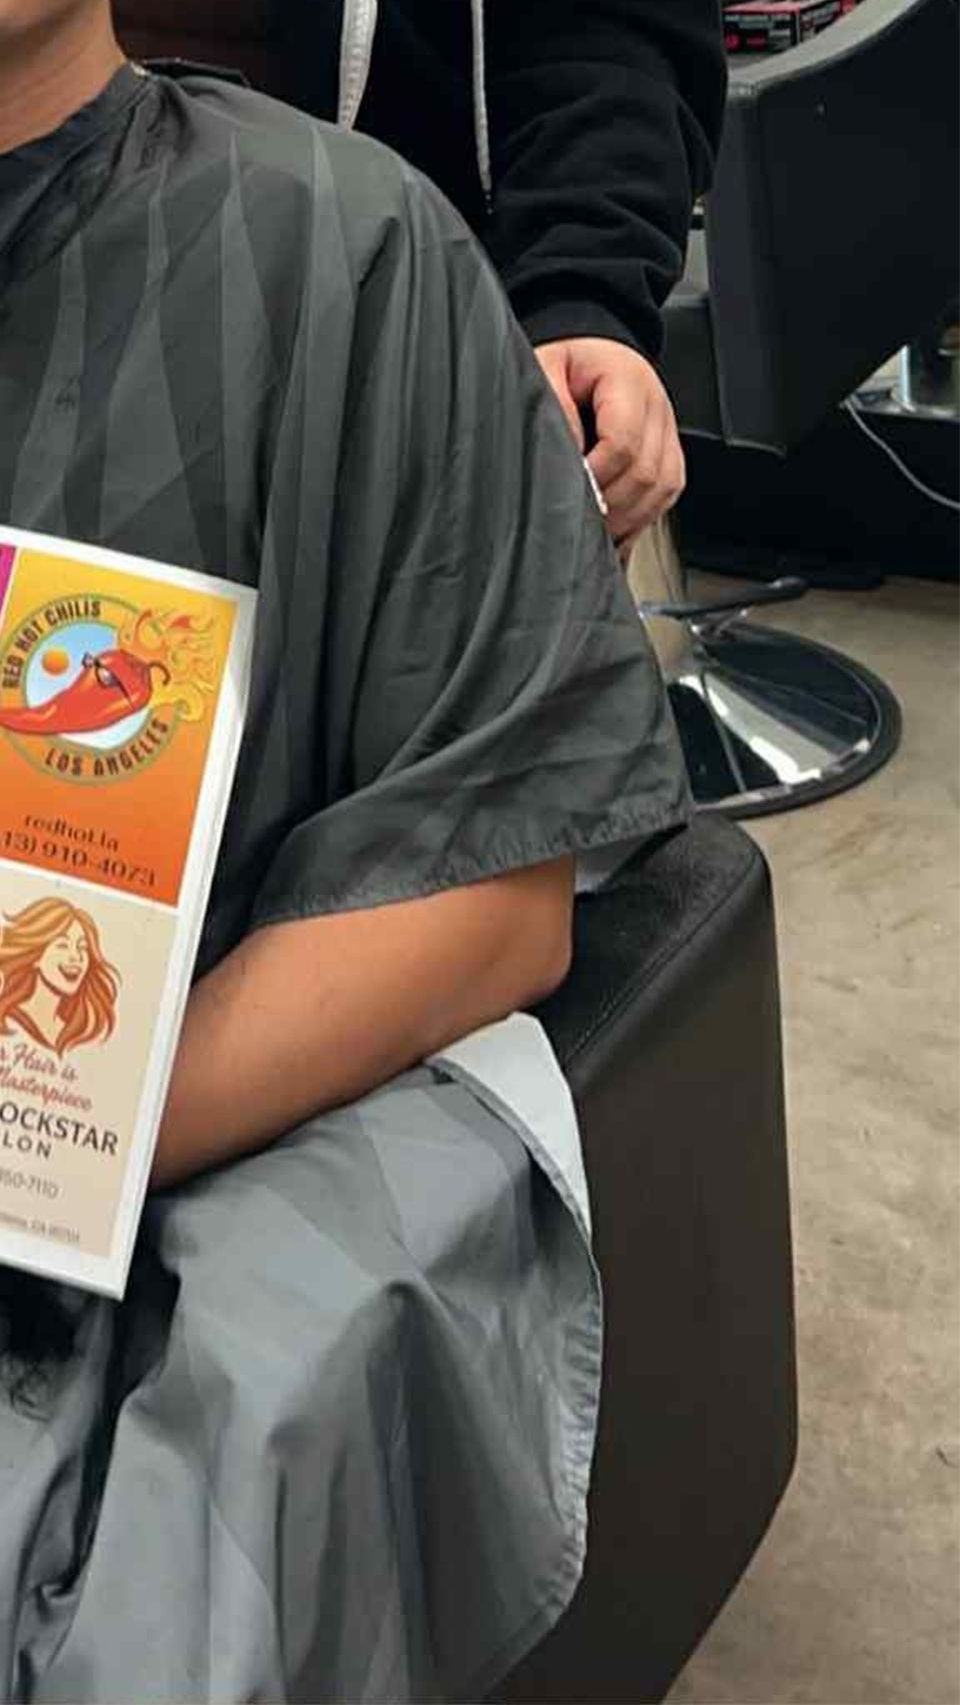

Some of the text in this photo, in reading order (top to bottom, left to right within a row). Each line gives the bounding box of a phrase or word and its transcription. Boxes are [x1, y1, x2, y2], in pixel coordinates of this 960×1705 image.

[2, 600, 102, 689] RED HOT CHILIS
[44, 718, 169, 777] LOS ANGELES
[13, 1043, 58, 1076] Hair
[60, 1066, 78, 1083] is
